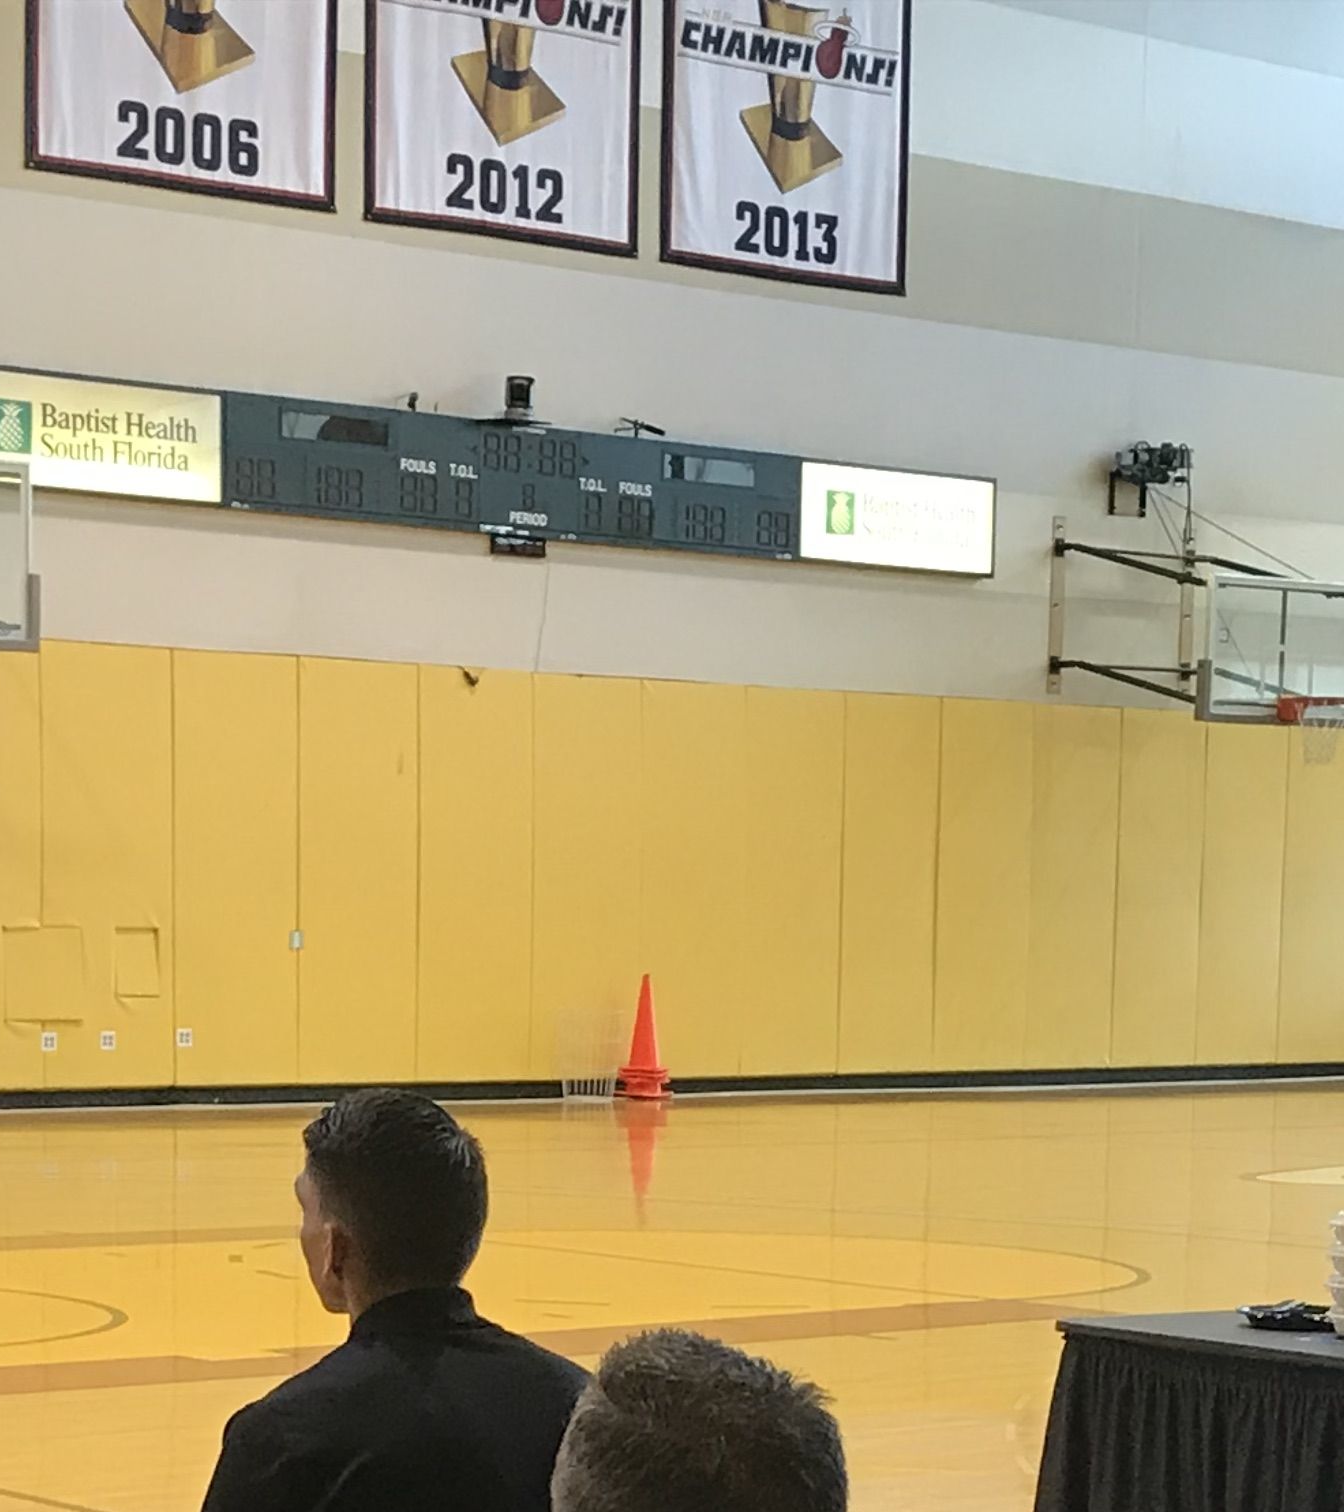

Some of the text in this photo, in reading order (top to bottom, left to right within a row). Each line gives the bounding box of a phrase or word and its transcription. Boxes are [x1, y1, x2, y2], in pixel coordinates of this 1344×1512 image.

[116, 100, 260, 178] 2006
[445, 152, 564, 225] 2012
[734, 201, 839, 267] 2013
[40, 402, 198, 443] Baptist Health
[40, 433, 190, 471] South Florida
[400, 458, 437, 475] FOULS
[618, 481, 652, 497] FOULS
[509, 510, 548, 527] PERIOD
